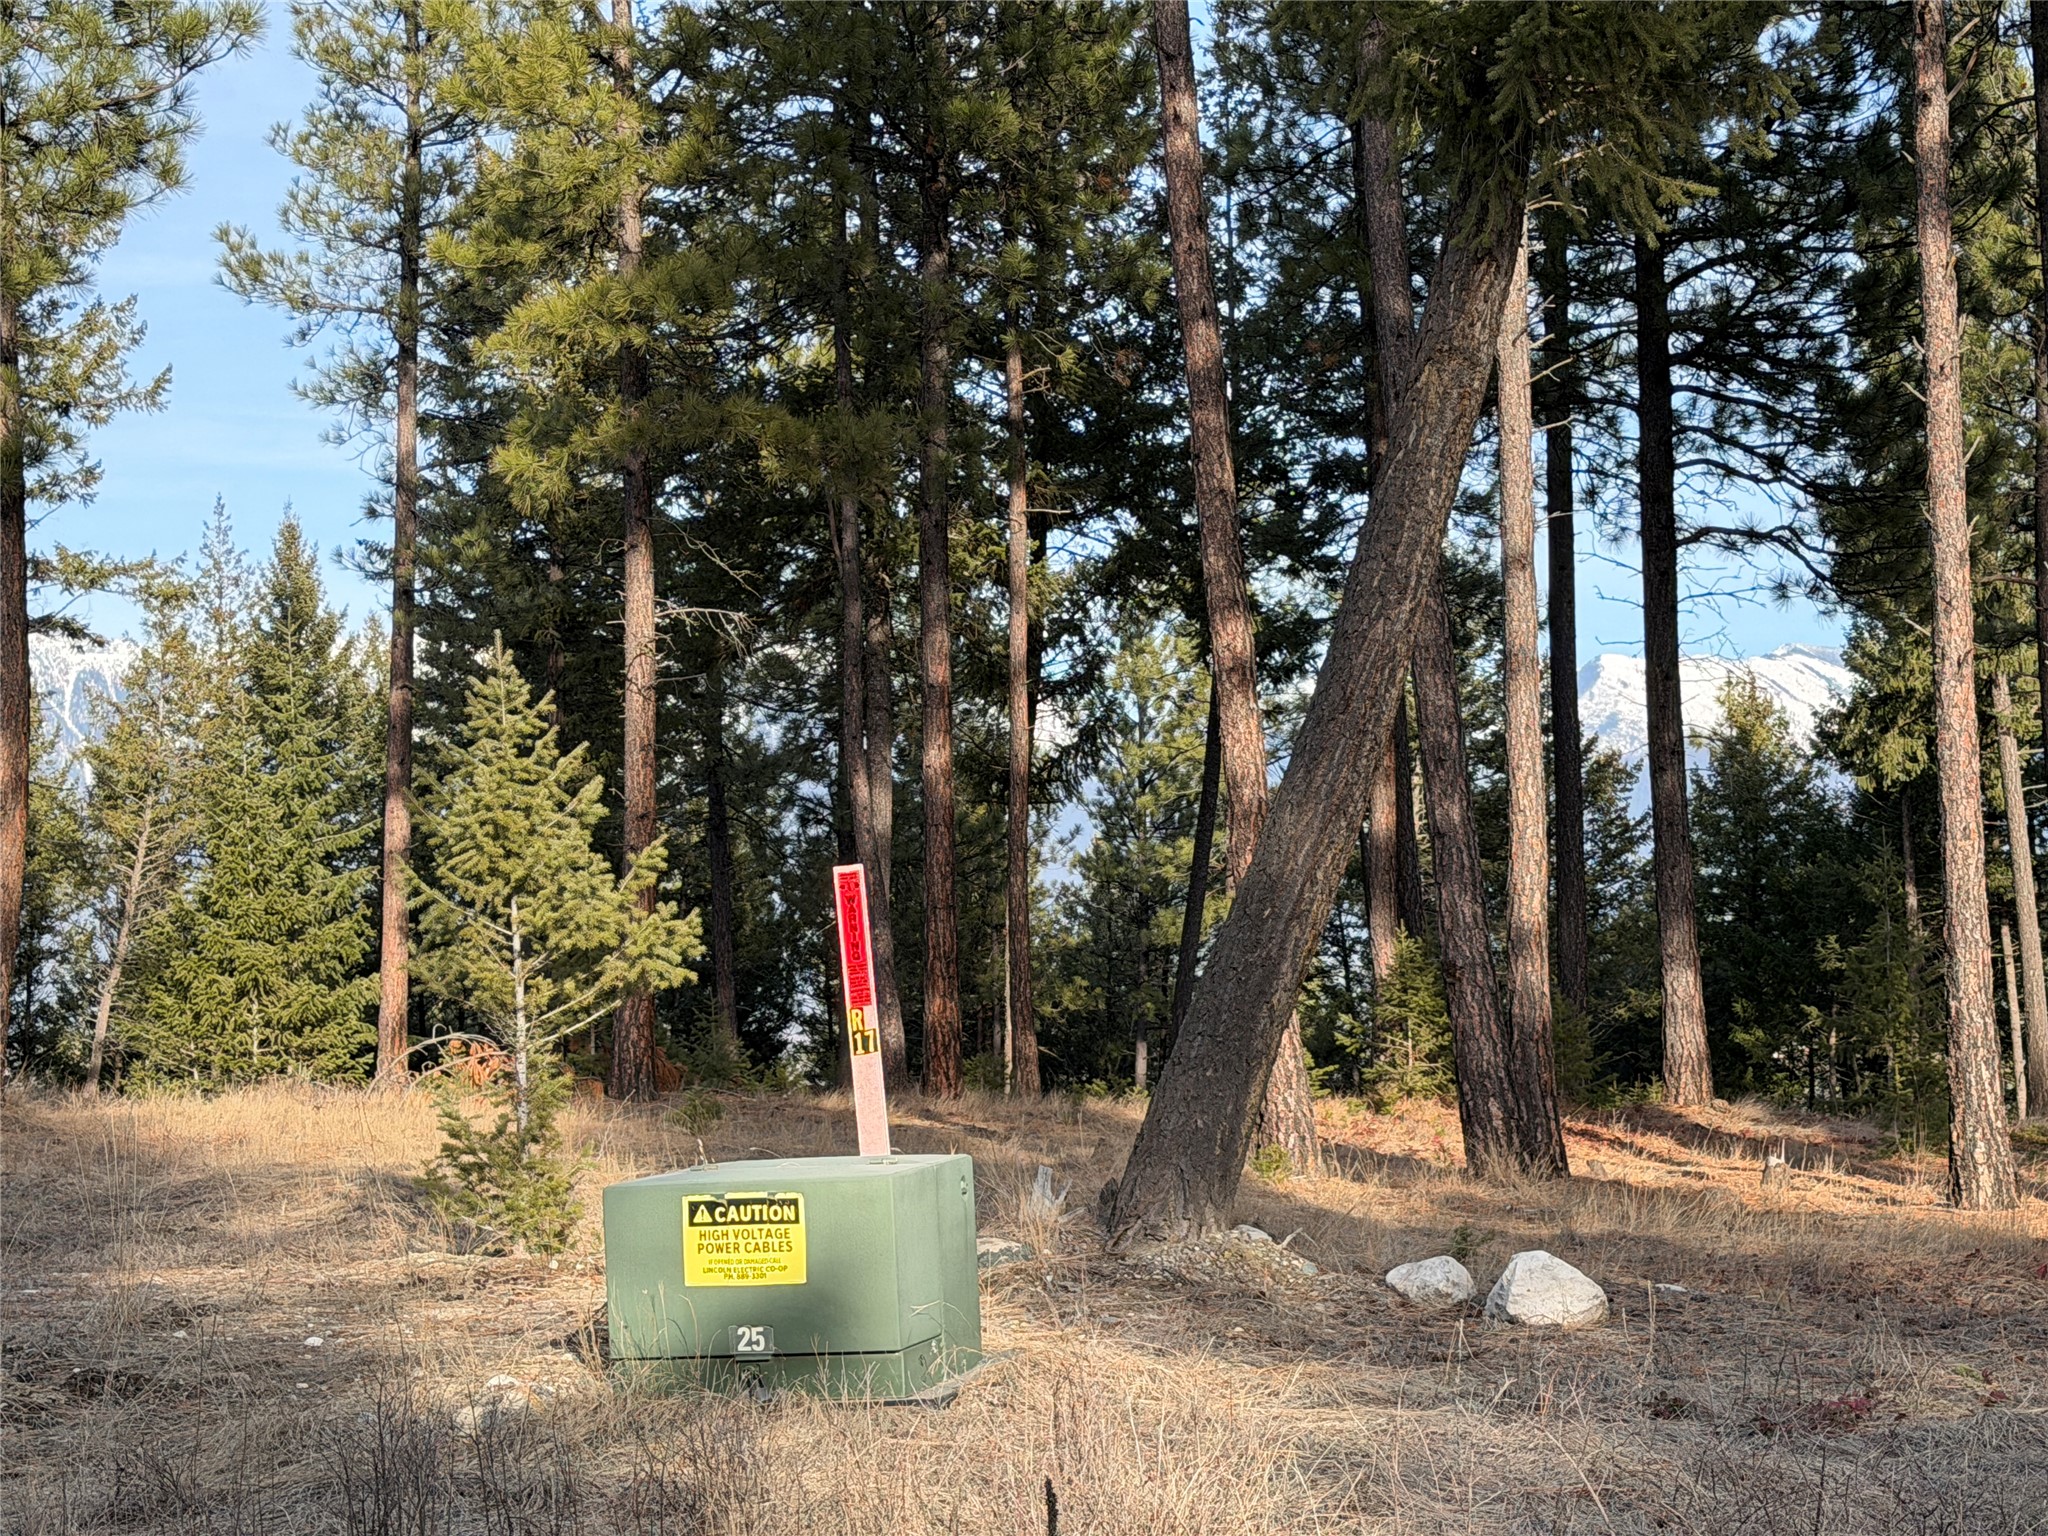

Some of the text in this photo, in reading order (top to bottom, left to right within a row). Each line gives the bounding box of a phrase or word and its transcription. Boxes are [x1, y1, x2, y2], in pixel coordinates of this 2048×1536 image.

[844, 894, 861, 961] WARNING
[851, 1008, 864, 1031] R
[853, 1029, 875, 1055] 17
[714, 1204, 796, 1222] CAUTION
[699, 1228, 791, 1241] HIGH VOLTAGE
[697, 1241, 793, 1254] POWER CABLES
[702, 1266, 732, 1274] LINCOLN
[733, 1266, 764, 1274] ELECTRIC
[737, 1326, 765, 1352] 25
